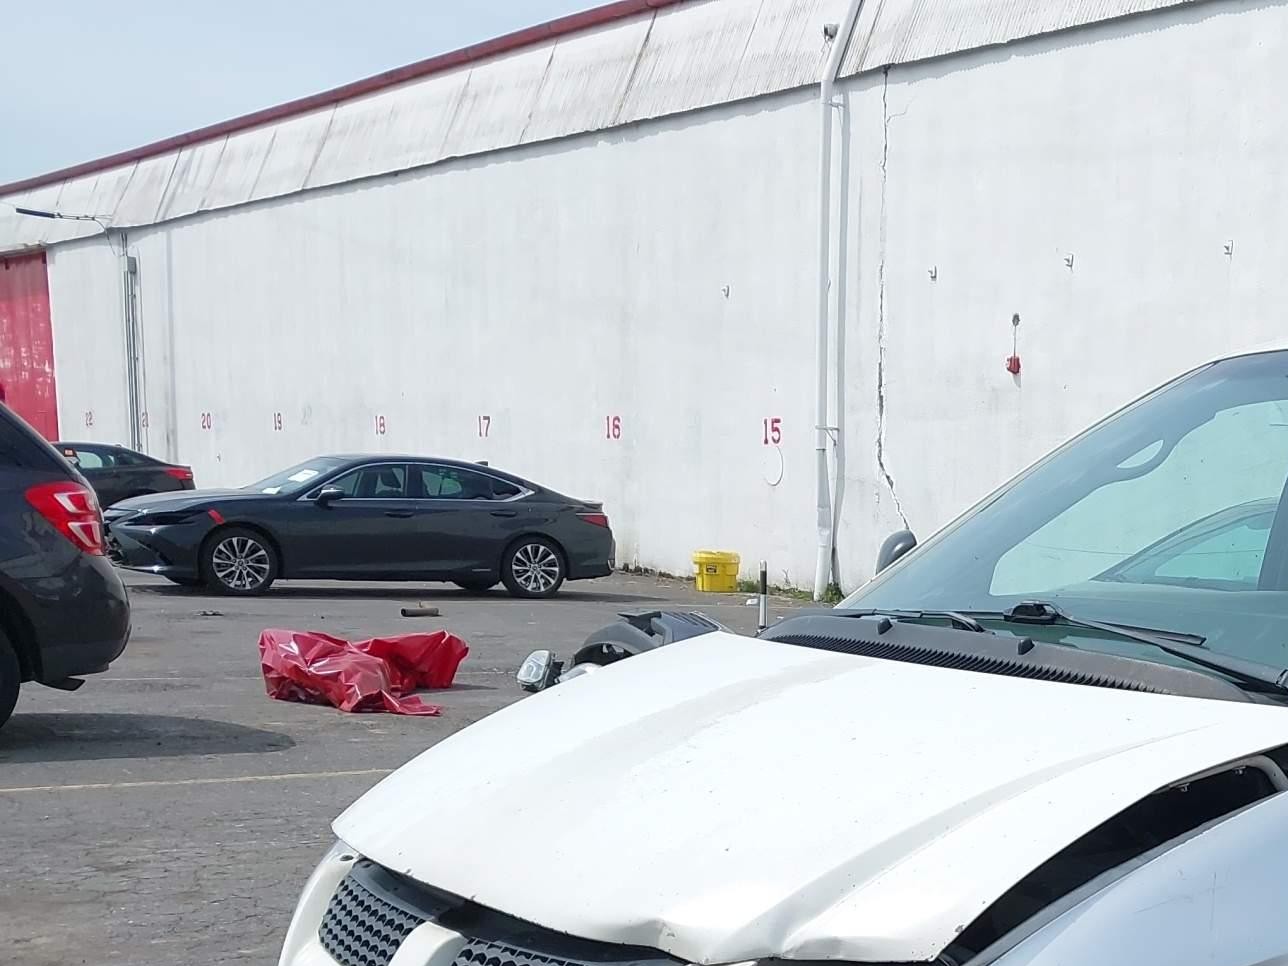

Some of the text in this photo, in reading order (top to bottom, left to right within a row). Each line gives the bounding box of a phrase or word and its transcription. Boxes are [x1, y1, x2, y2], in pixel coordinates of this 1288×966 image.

[201, 412, 212, 430] 20
[273, 412, 283, 431] 19
[374, 415, 386, 435] 18
[478, 415, 491, 437] 17
[606, 415, 621, 440] 16
[763, 417, 782, 445] 15
